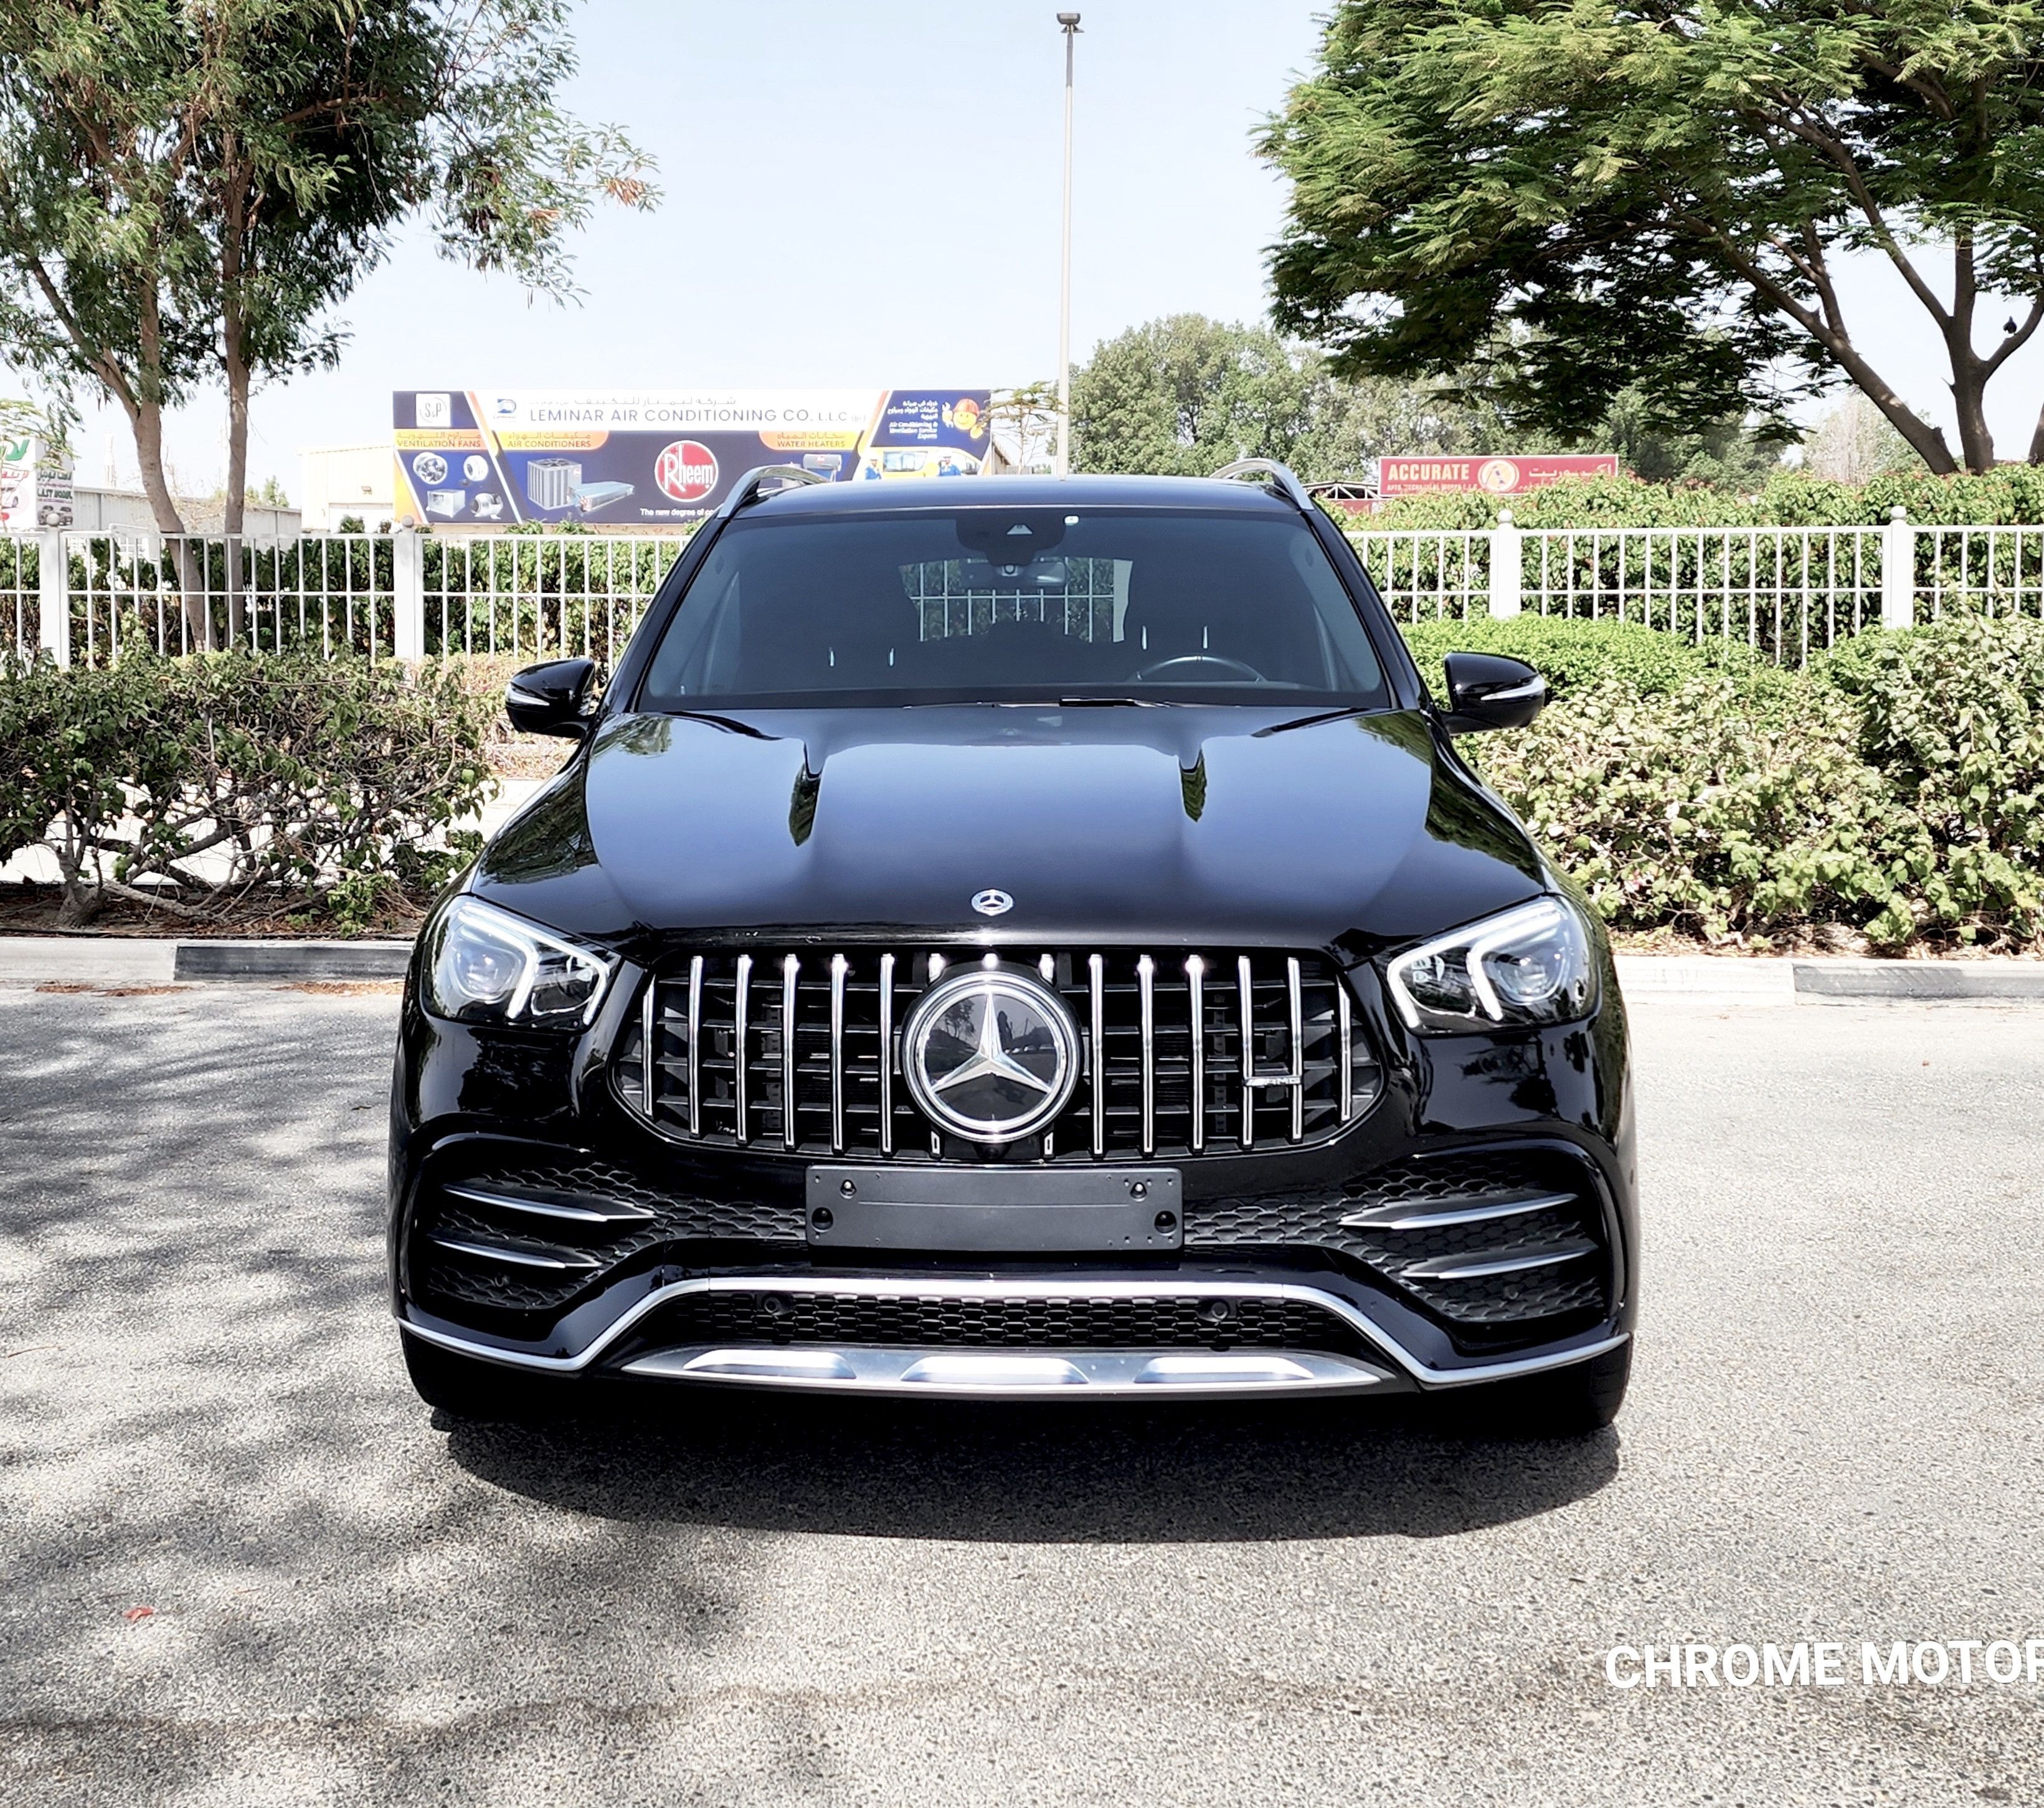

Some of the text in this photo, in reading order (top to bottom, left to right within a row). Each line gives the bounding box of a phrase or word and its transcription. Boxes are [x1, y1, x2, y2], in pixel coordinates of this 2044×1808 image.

[530, 409, 603, 422] LEMINAR
[611, 409, 638, 422] AIR
[645, 409, 777, 422] CONDITIONING
[783, 409, 813, 422] CO.
[664, 444, 714, 492] Rheem
[1388, 463, 1470, 481] ACCURATE
[671, 508, 695, 517] degree
